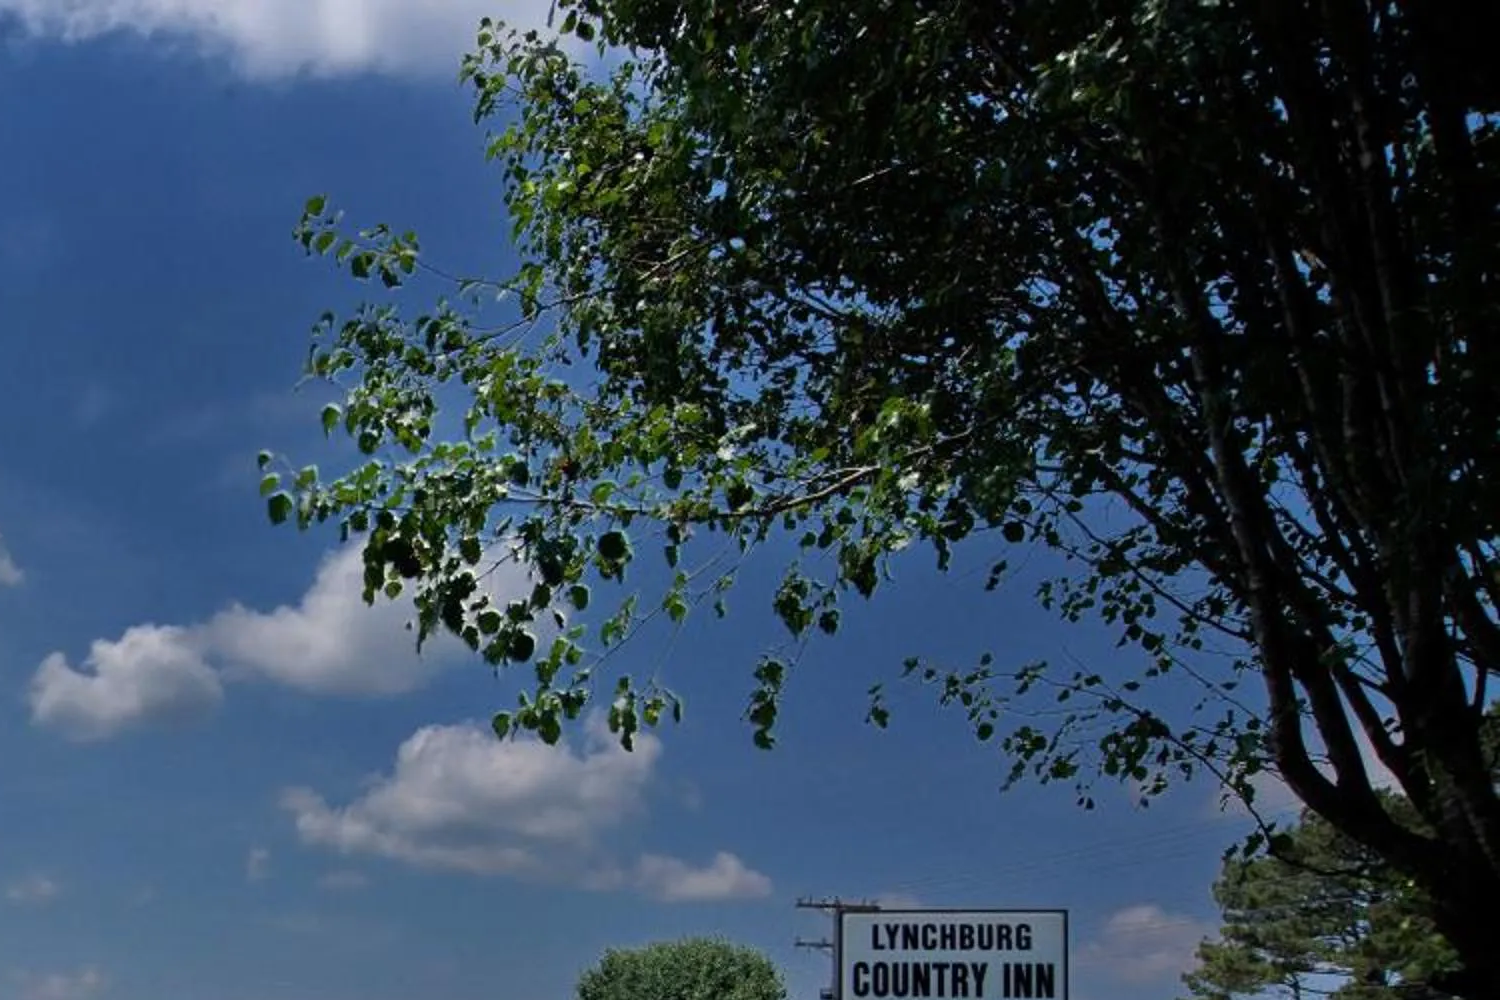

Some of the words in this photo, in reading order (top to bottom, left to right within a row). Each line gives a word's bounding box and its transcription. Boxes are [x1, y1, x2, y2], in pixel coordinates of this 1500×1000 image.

[872, 923, 1032, 951] LYNCHBURG
[853, 962, 988, 998] COUNTRY
[1003, 963, 1055, 999] INN
